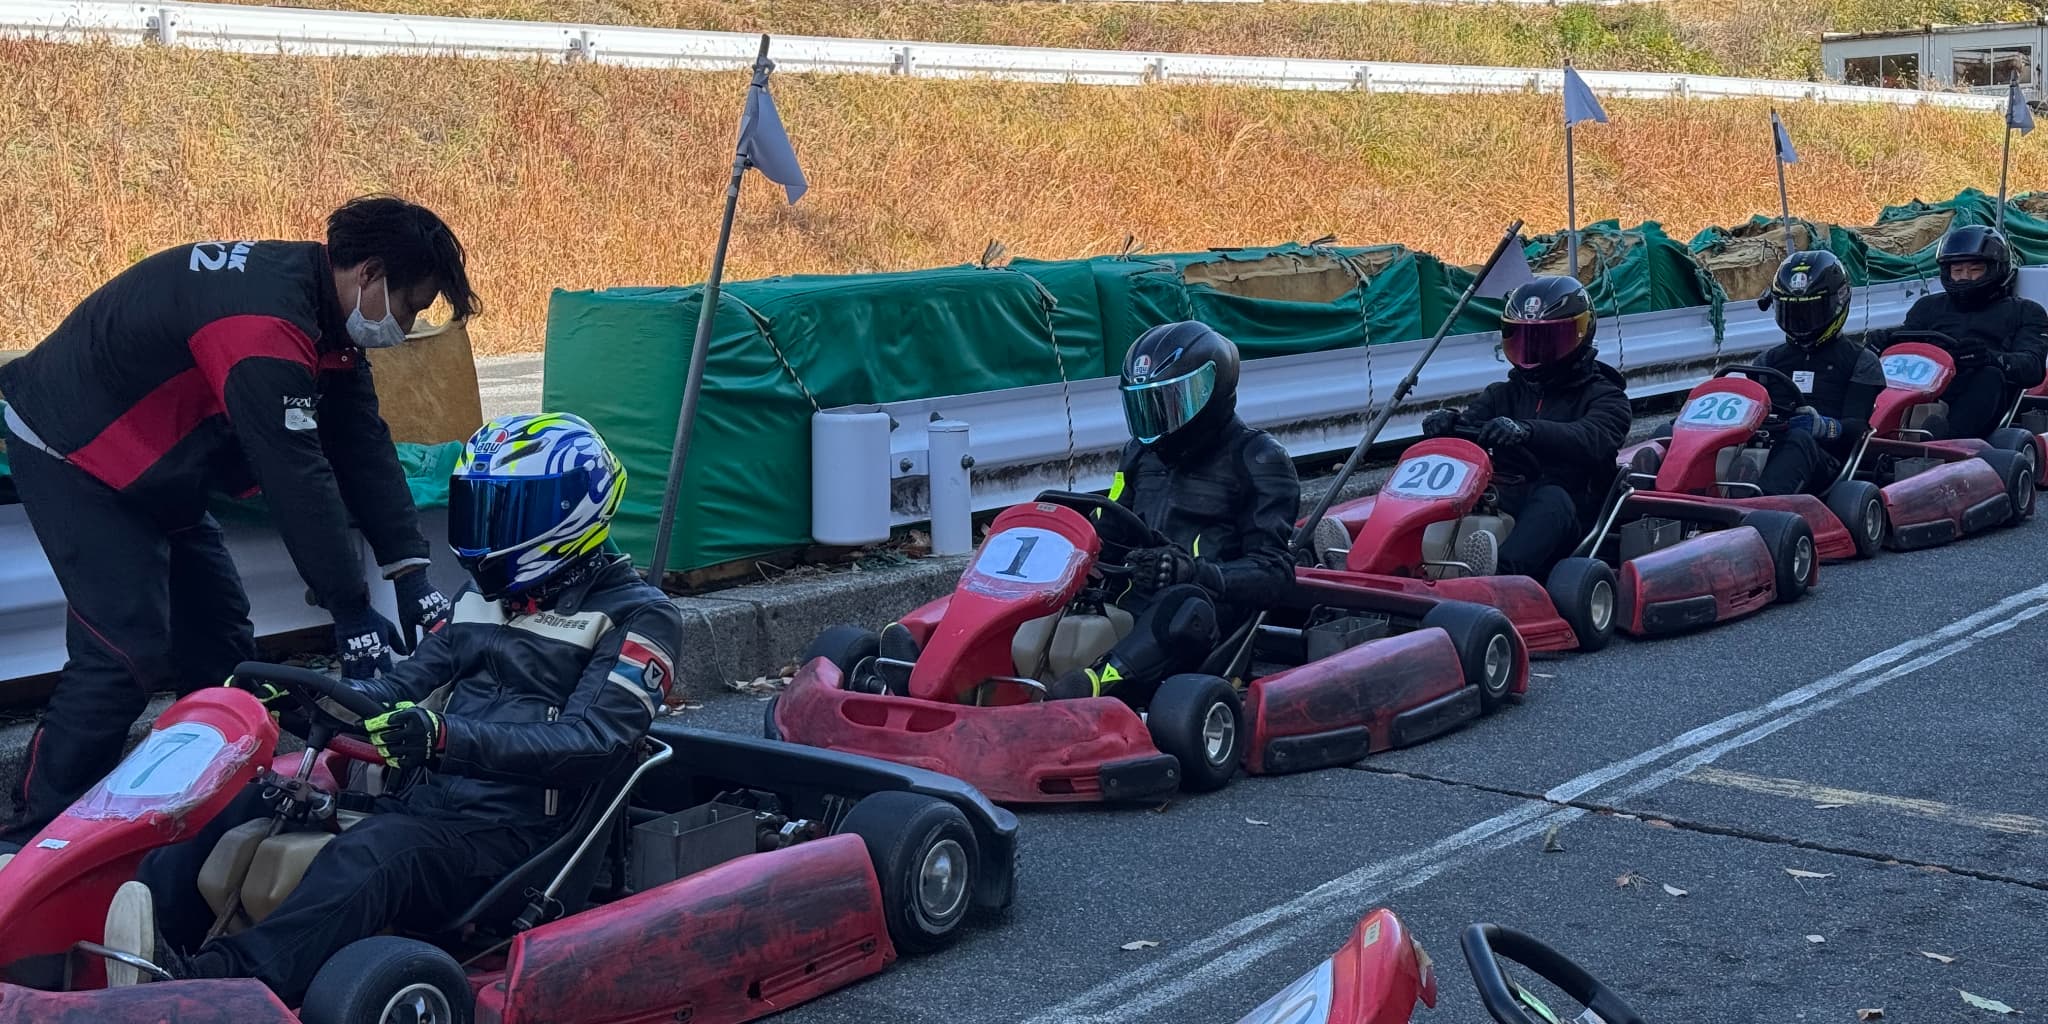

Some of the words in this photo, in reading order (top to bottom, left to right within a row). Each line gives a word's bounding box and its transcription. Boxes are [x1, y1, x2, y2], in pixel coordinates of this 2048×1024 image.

[1884, 356, 1930, 381] 30
[1691, 396, 1742, 421] 26
[1398, 461, 1455, 491] 20
[995, 536, 1039, 579] 1
[129, 732, 201, 790] 7
